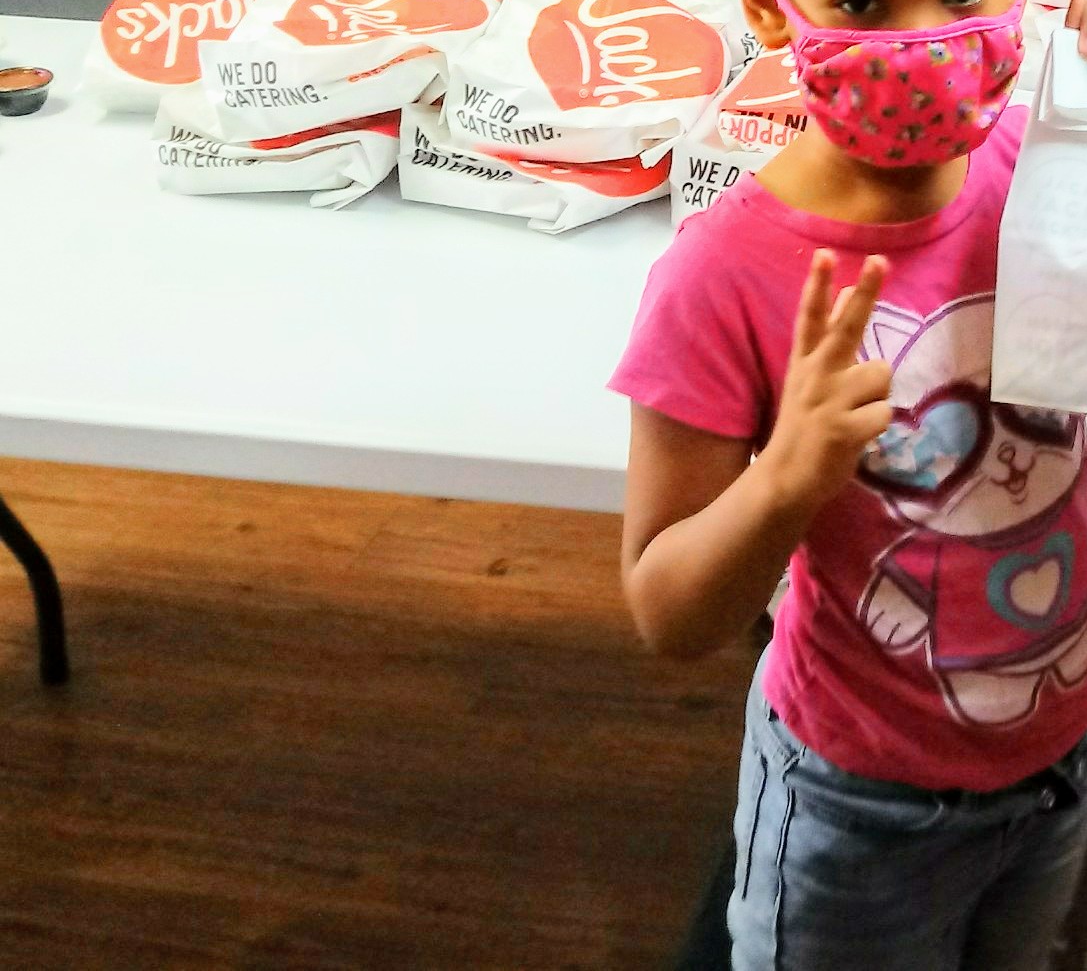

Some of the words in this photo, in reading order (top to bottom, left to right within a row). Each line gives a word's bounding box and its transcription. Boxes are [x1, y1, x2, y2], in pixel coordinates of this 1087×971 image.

[217, 62, 244, 86] WE
[250, 59, 278, 86] DO
[223, 83, 329, 109] CATERING.
[463, 83, 495, 113] WE
[488, 97, 521, 124] DO
[455, 109, 563, 146] CATERING.
[688, 156, 722, 185] WE
